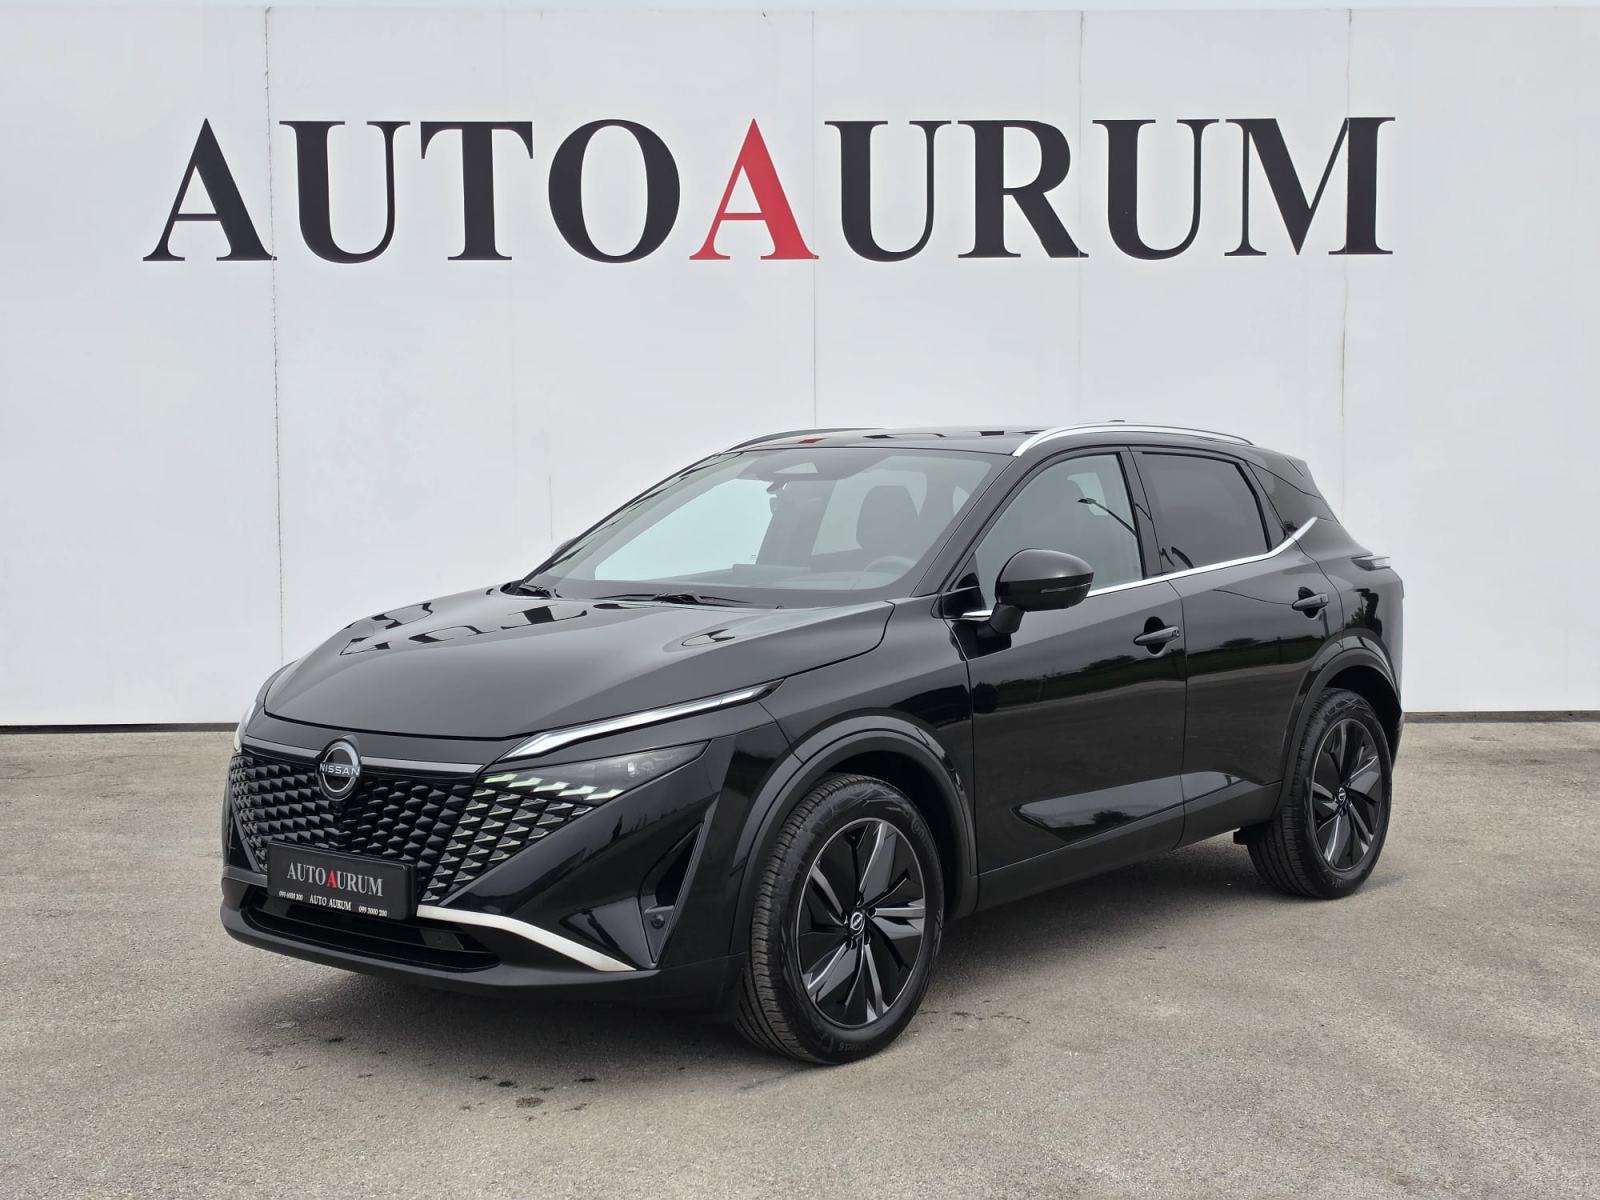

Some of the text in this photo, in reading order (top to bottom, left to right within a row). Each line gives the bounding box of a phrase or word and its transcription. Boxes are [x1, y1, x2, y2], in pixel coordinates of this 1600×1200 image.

[142, 116, 1396, 264] AUTOAURUM
[319, 762, 360, 776] NISSAN
[287, 861, 384, 897] AUTOAURUM
[309, 894, 352, 912] AUTO AURUM
